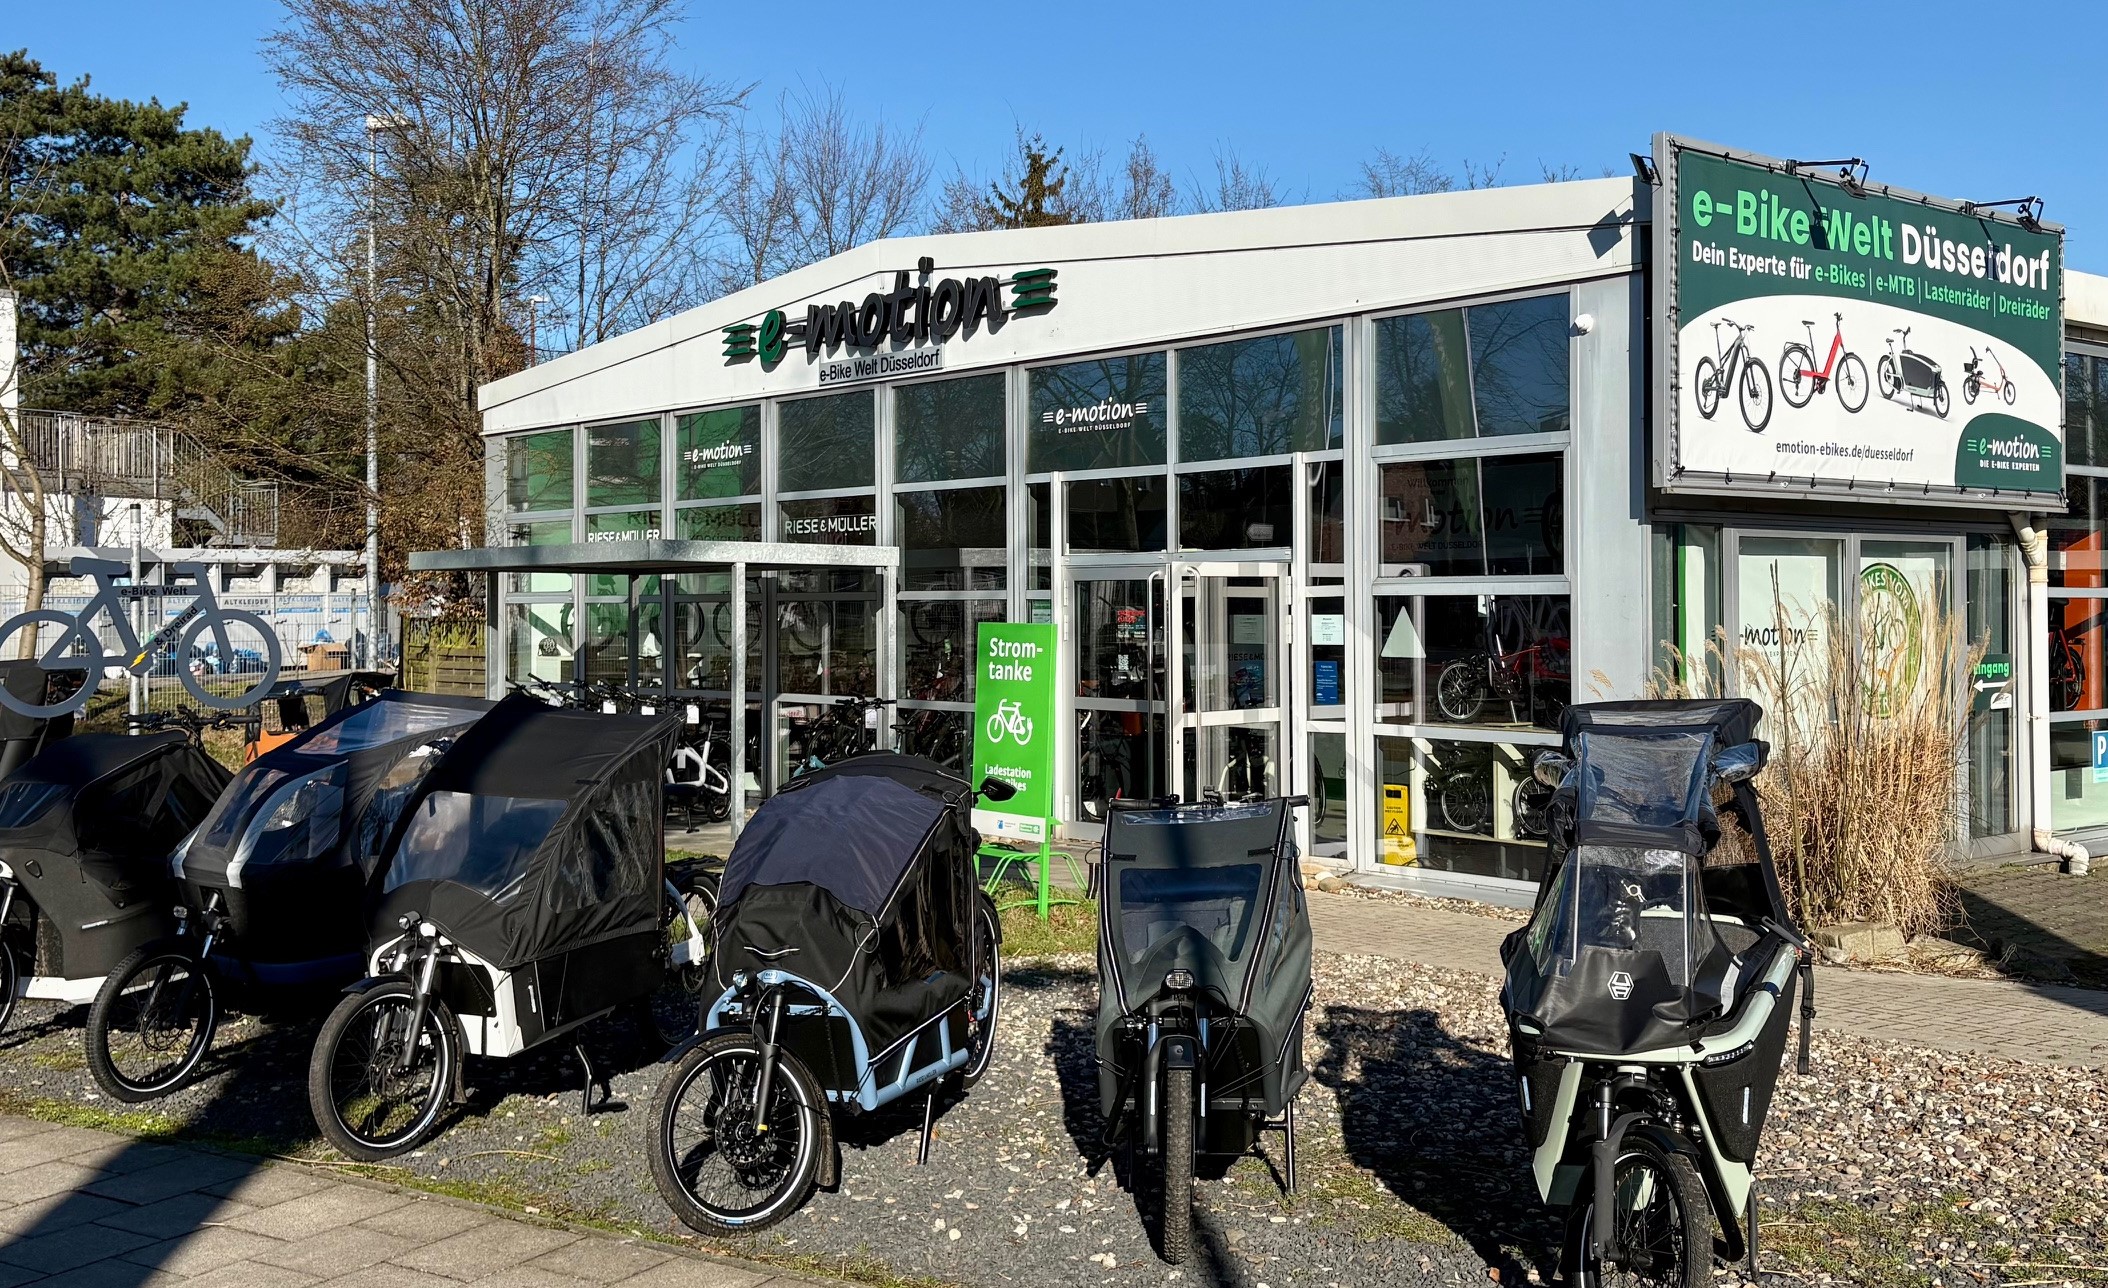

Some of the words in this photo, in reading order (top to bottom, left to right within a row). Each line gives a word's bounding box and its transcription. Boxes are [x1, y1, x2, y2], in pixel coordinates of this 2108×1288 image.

[1692, 189, 1811, 246] e-Bike
[1819, 206, 1895, 261] Welt
[1901, 222, 2050, 291] Düsseldorf
[1692, 240, 1725, 267] Dein
[1729, 247, 1786, 276] Experte
[1790, 256, 1812, 280] für
[1814, 263, 1866, 289] e-Bikes
[1875, 274, 1915, 297] e-MTB
[1924, 280, 1991, 311] Lastenräder
[1999, 295, 2051, 321] Dreiräder
[758, 256, 1004, 363] e-motion
[819, 366, 852, 383] e-Bike
[854, 360, 879, 378] Welt
[880, 349, 940, 373] Düsseldorf
[1055, 396, 1134, 425] e-motion
[692, 440, 744, 463] e-motion
[1776, 440, 1914, 462] emotion-ebikes.de/duesseldorf
[1979, 433, 2040, 459] e-motion
[1979, 459, 1990, 468] DIE
[2011, 462, 2040, 472] EXPERTEN
[784, 517, 819, 536] RIESE
[828, 514, 877, 535] MÜLLER
[120, 587, 157, 596] e-Bike
[162, 587, 188, 596] Welt
[223, 598, 269, 606] ALTKLEIDER
[154, 637, 163, 646] &
[163, 605, 199, 638] Dreirad
[989, 637, 1044, 659] Strom-
[988, 659, 1033, 682] tanke
[2097, 735, 2107, 766] P
[984, 762, 1032, 780] Ladestation
